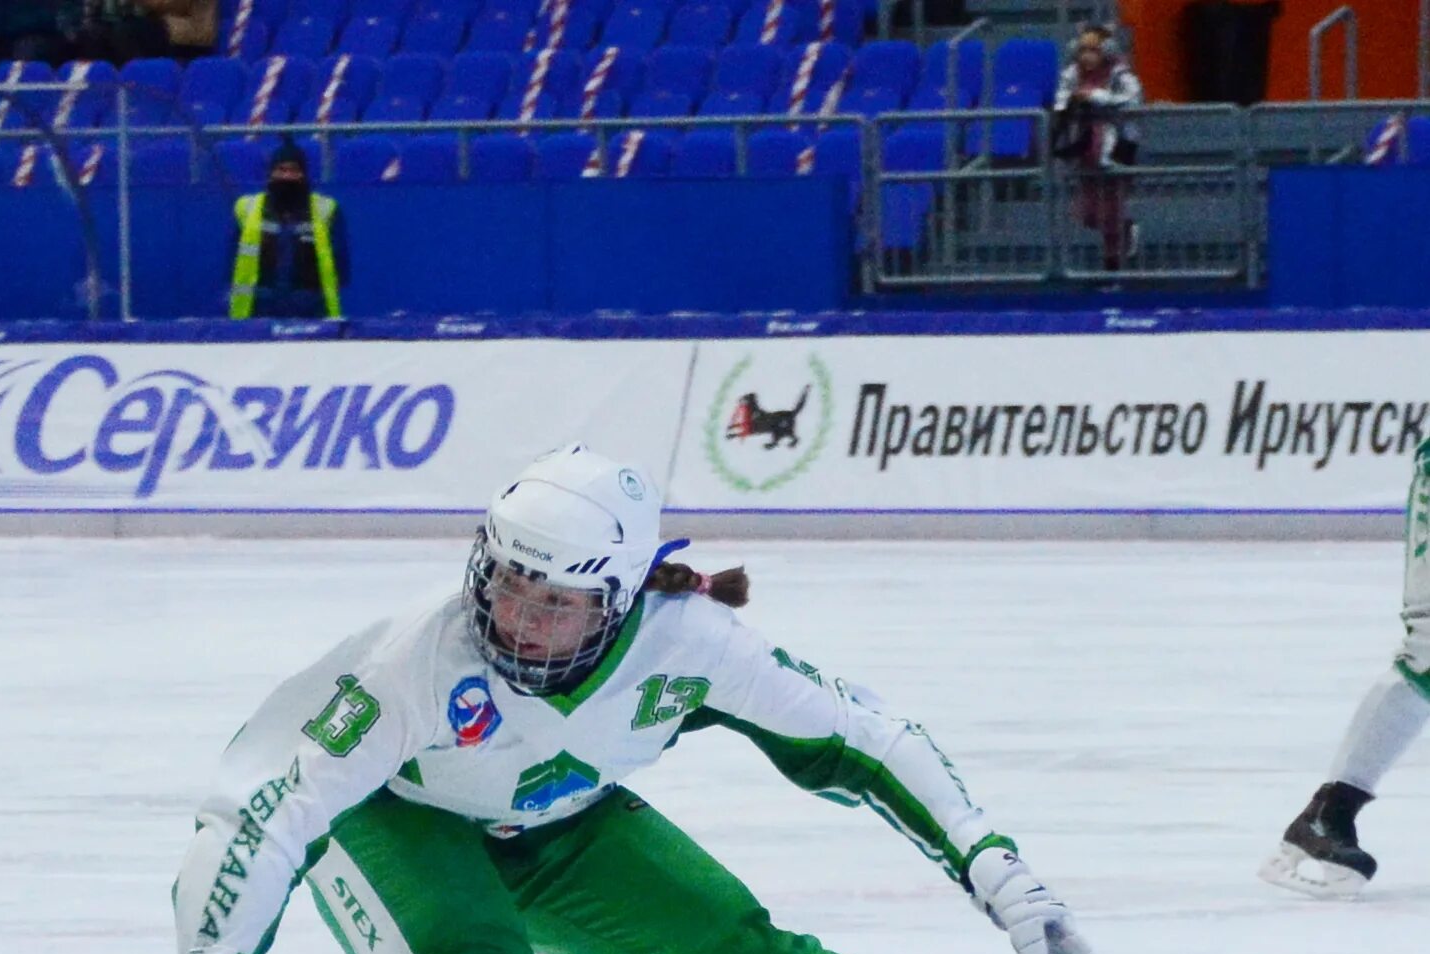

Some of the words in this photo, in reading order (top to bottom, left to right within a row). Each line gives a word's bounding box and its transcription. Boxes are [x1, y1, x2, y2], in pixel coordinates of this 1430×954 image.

[848, 383, 1207, 470] Правительство
[512, 539, 555, 563] Reebok
[301, 673, 382, 758] 13
[631, 673, 713, 731] 13
[331, 876, 383, 952] STEX
